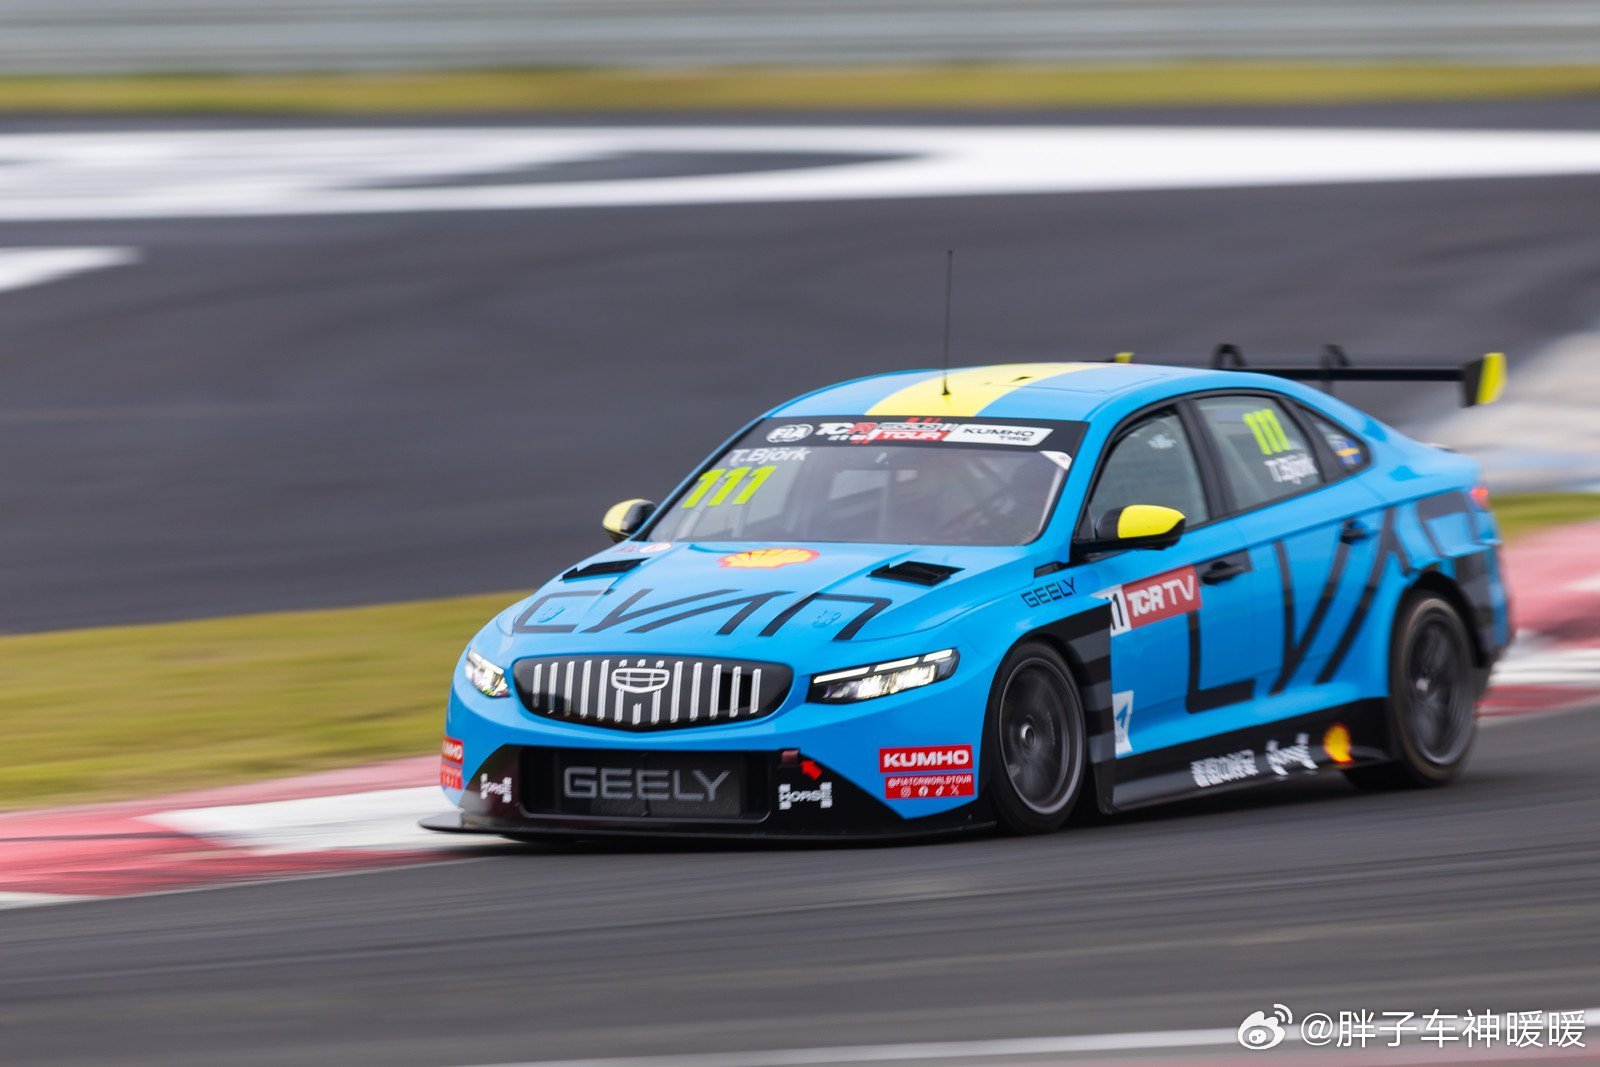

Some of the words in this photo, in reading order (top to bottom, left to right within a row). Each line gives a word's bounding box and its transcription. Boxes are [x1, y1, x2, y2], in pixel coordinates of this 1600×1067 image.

[815, 422, 878, 435] TCR
[882, 431, 941, 440] TOUR
[963, 427, 1035, 437] KUMHO
[1243, 409, 1290, 455] 111
[729, 447, 812, 467] T.Björk
[681, 465, 778, 508] 111
[1021, 576, 1077, 608] GEELY
[1126, 585, 1165, 618] TCR
[1164, 575, 1194, 606] TV
[883, 749, 970, 768] KUMHO
[563, 766, 731, 801] GEELY
